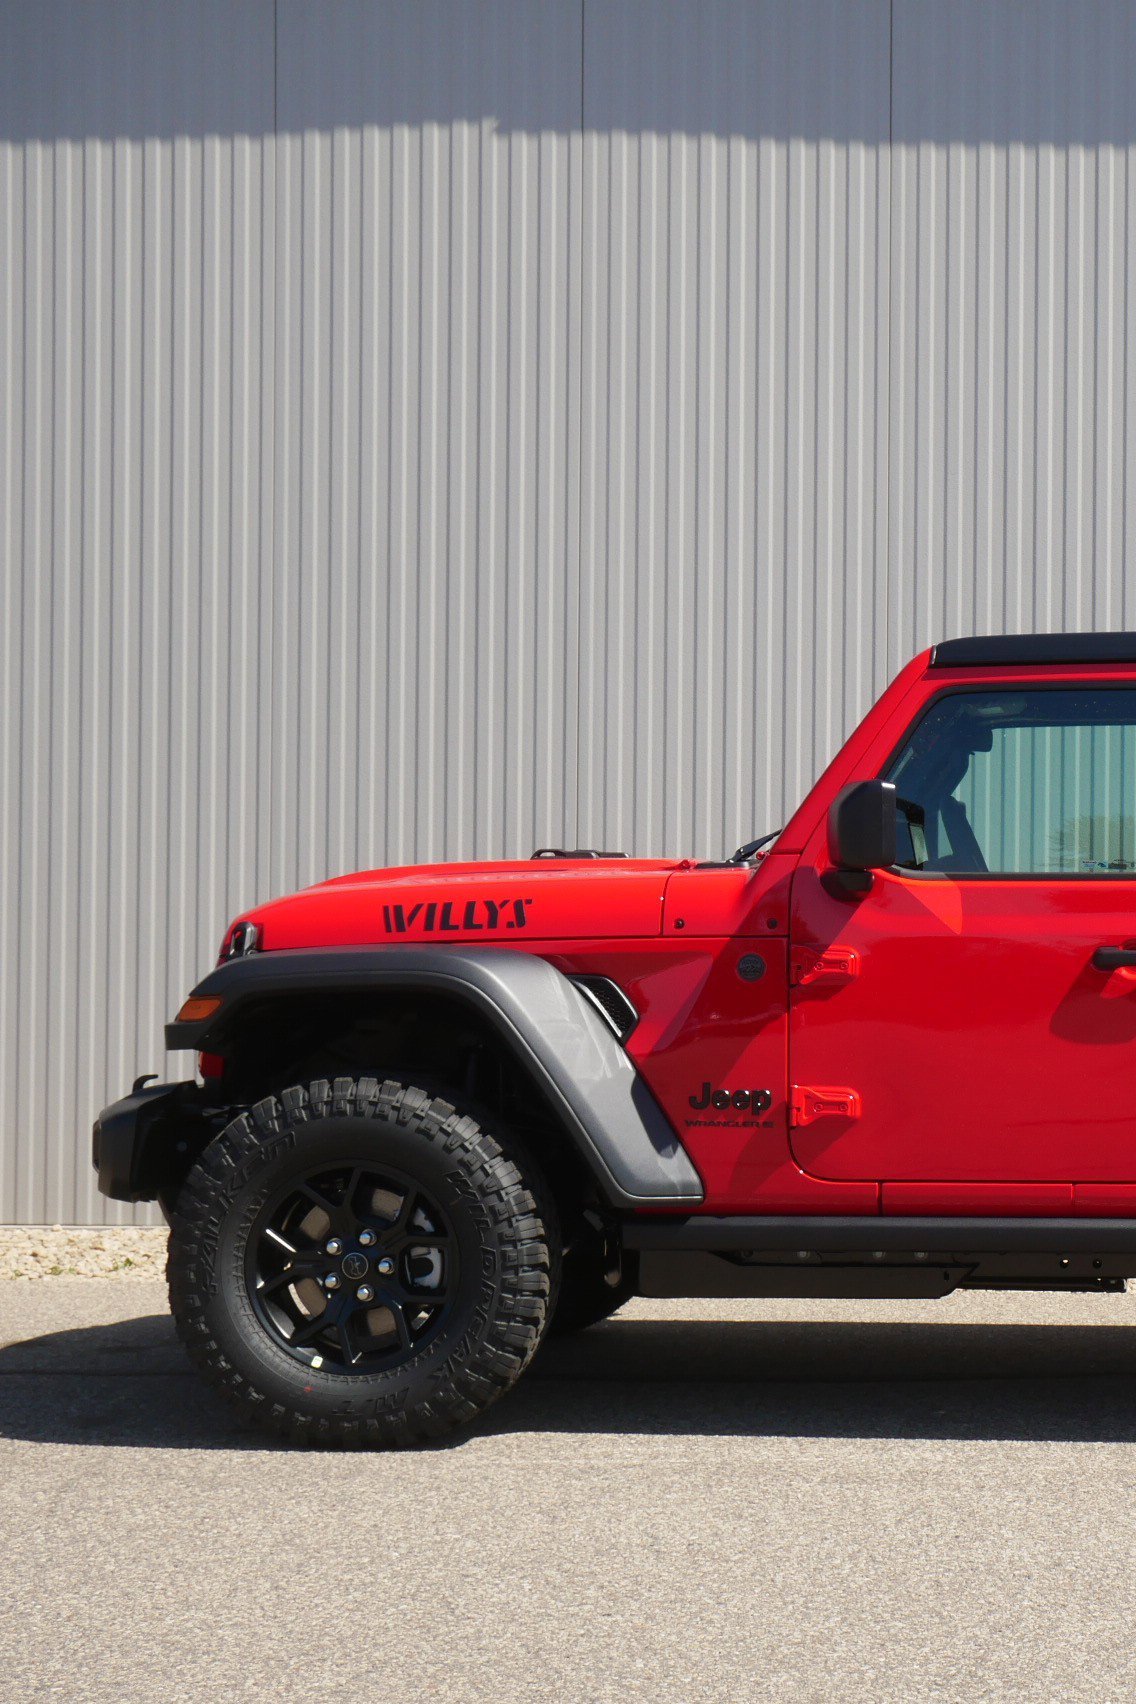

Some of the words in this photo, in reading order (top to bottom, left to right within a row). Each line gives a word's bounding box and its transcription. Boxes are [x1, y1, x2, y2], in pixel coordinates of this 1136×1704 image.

[383, 898, 533, 933] WILLYS
[688, 1082, 772, 1116] Jeep
[684, 1119, 760, 1128] WRANGLER
